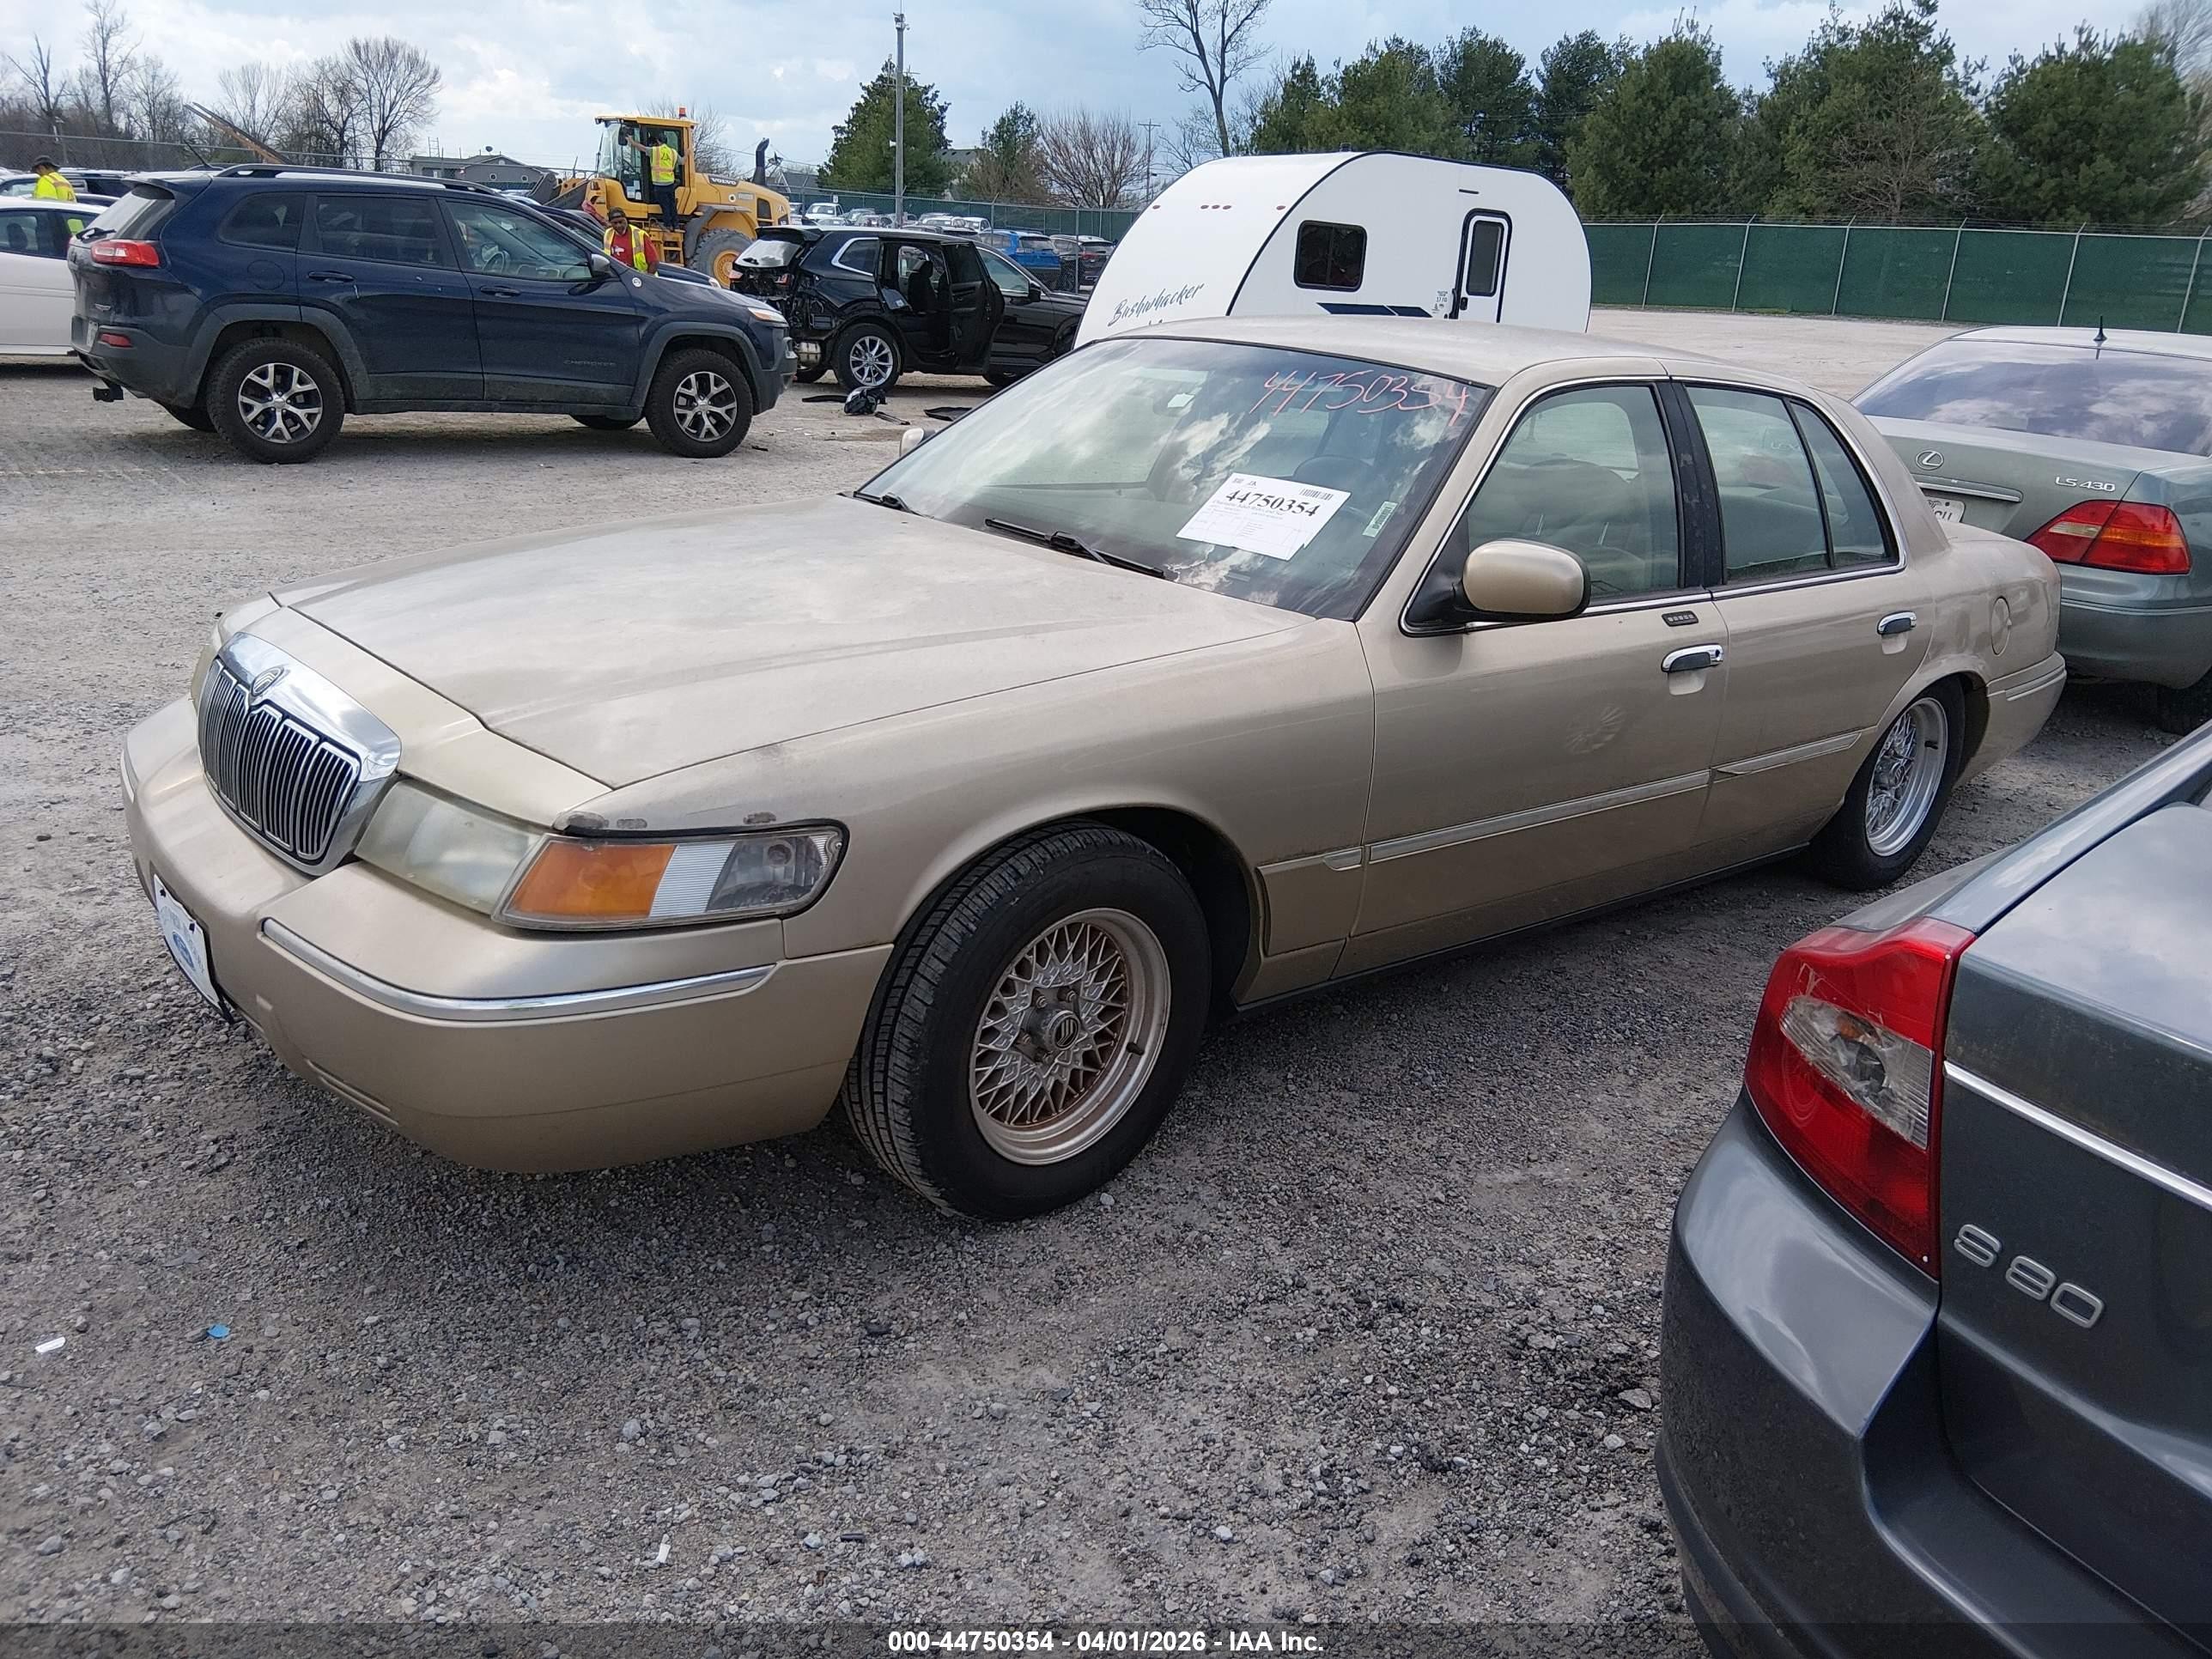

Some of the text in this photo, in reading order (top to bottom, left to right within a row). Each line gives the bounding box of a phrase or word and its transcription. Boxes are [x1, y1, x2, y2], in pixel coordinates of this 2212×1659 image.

[711, 177, 737, 185] VOLVO
[1107, 283, 1205, 327] Bushwhacker
[1249, 369, 1469, 427] 44750354
[2055, 477, 2116, 492] LS 430
[1225, 489, 1321, 517] 44750354
